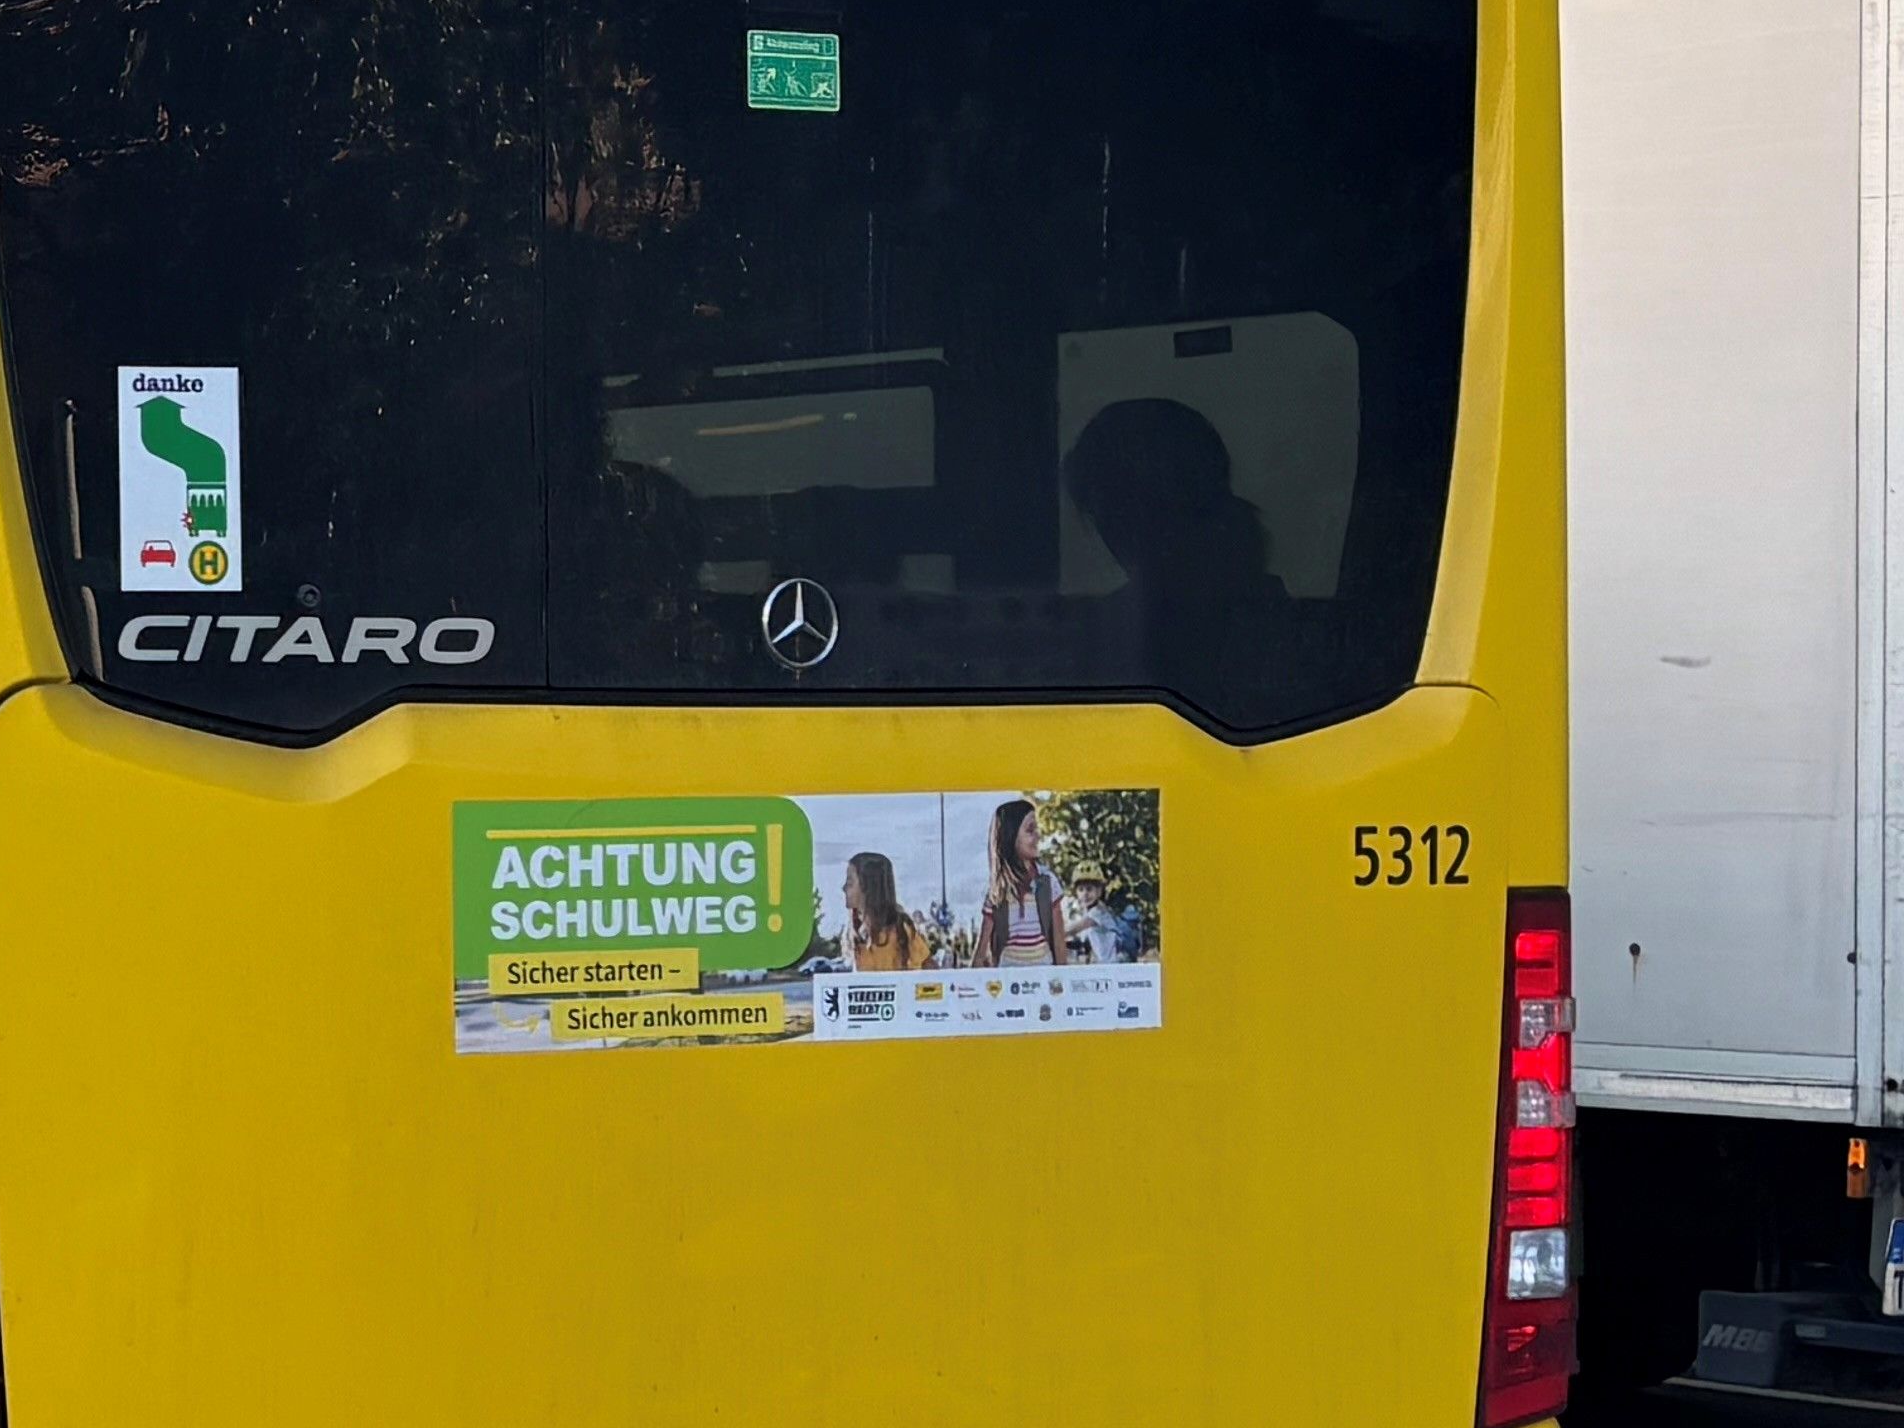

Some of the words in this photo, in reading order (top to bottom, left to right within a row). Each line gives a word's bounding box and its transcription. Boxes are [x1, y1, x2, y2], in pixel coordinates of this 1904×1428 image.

[132, 373, 205, 394] danke
[117, 614, 496, 665] CITARO
[491, 840, 757, 890] ACHTUNG
[1354, 824, 1470, 887] 5312
[490, 894, 757, 941] SCHULWEG
[507, 960, 580, 985] Sicher
[583, 960, 664, 983] starten
[567, 1006, 640, 1031] Sicher
[643, 1004, 768, 1029] ankommen
